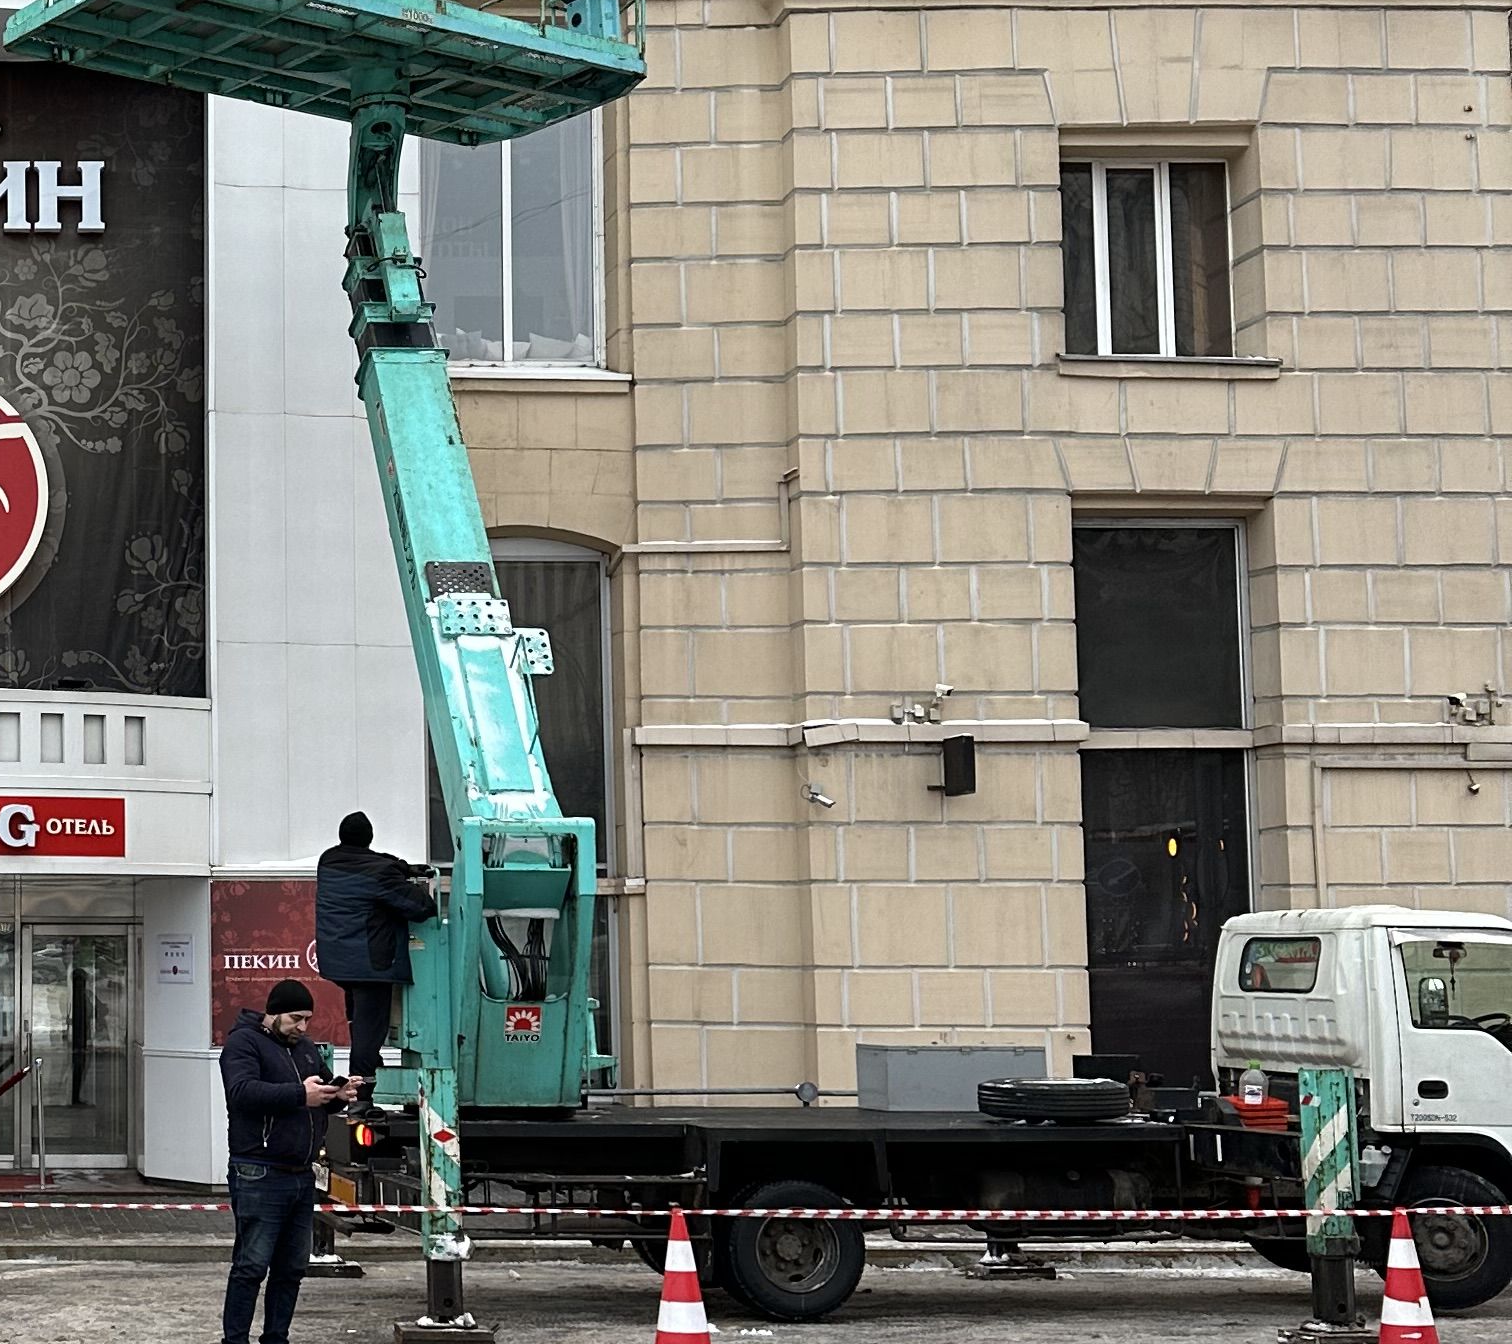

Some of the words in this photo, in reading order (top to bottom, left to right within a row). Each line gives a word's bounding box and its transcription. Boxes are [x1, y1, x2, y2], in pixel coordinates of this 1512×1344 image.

[46, 818, 115, 836] ОТЕЛЬ
[223, 954, 301, 969] ПЕКИН
[505, 1034, 540, 1042] TAIYO
